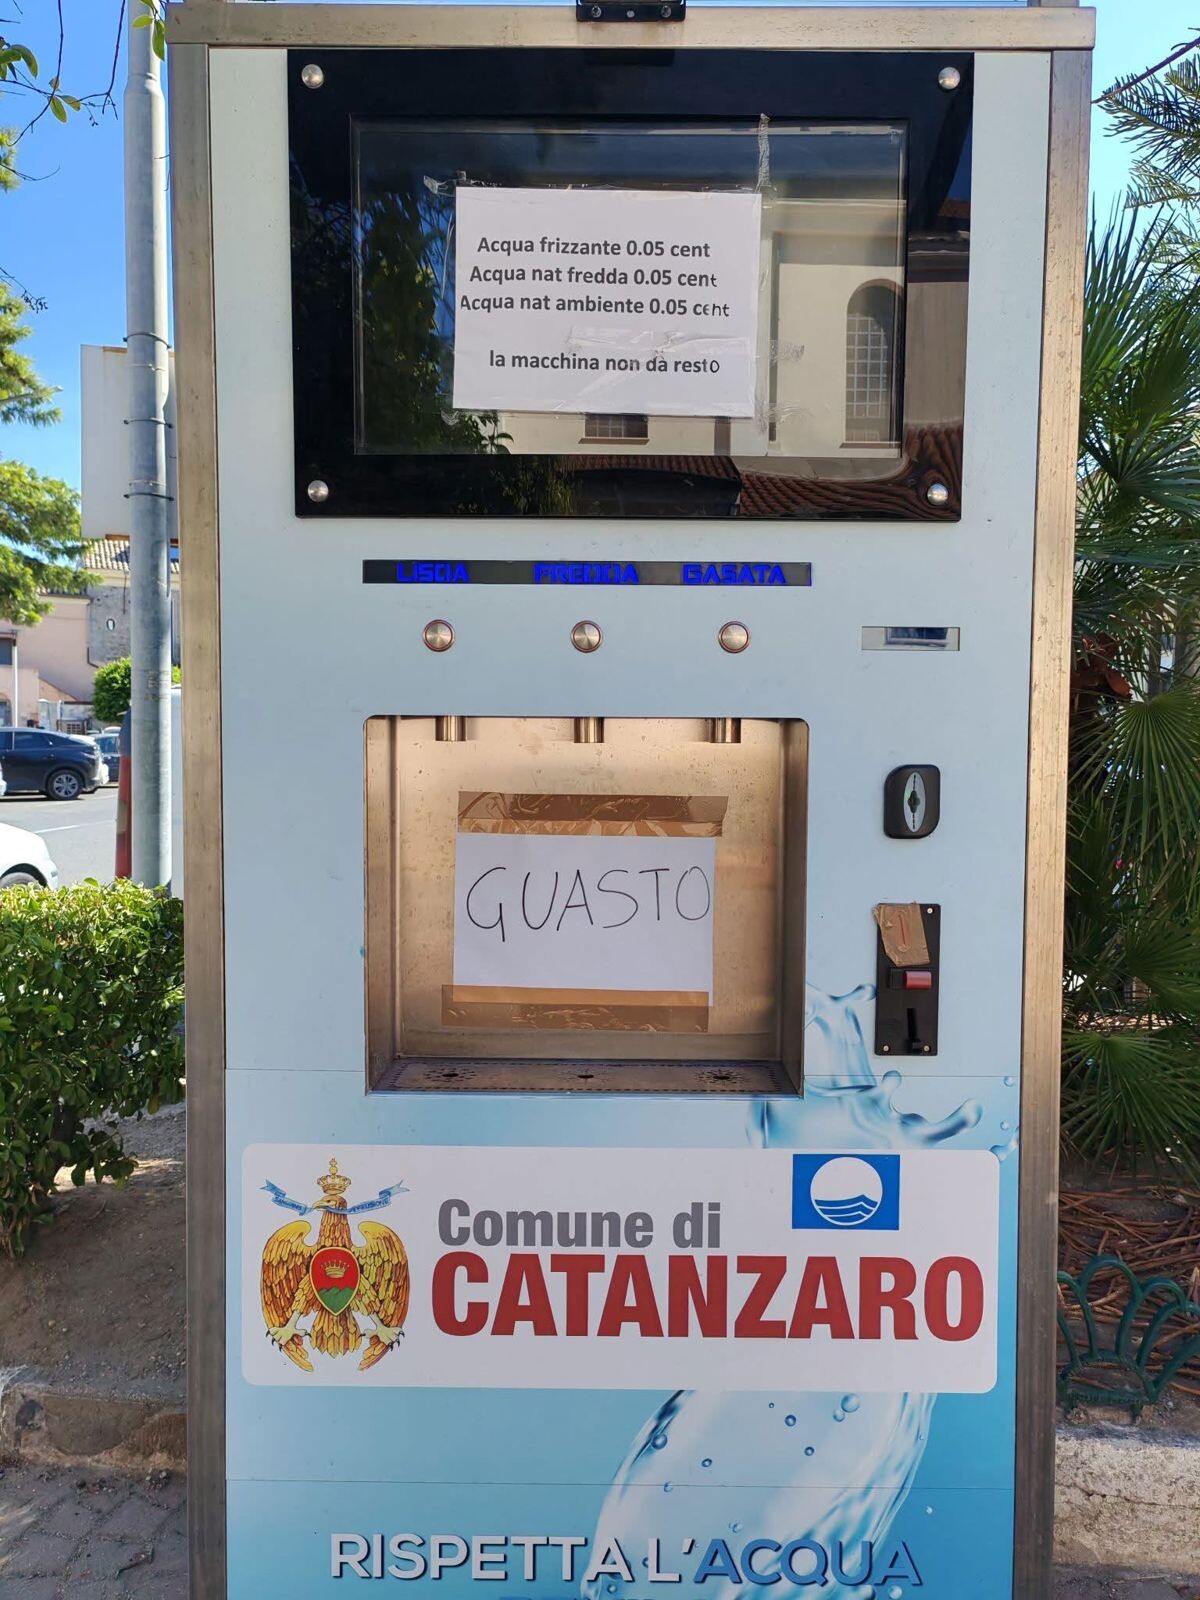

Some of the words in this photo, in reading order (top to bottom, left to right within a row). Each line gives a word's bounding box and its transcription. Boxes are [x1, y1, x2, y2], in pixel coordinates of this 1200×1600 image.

[477, 237, 534, 256] Acqua
[540, 236, 621, 256] frizzante
[626, 239, 665, 256] 0.05
[670, 243, 711, 258] cent
[469, 265, 526, 285] Acqua
[532, 267, 562, 282] nat
[567, 266, 628, 285] fredda
[633, 269, 672, 286] 0.05
[677, 273, 718, 288] cent
[460, 295, 514, 313] Acqua
[520, 295, 550, 311] nat
[556, 295, 644, 313] ambiente
[649, 298, 688, 315] 0.05
[693, 303, 730, 317] cent
[489, 350, 505, 367] la
[511, 352, 600, 370] macchina
[605, 358, 641, 372] non
[673, 359, 720, 374] resto
[534, 563, 640, 585] FREDDA
[683, 563, 786, 585] GASATA
[466, 866, 711, 943] GUASTO
[437, 1198, 654, 1249] Comune
[672, 1201, 721, 1249] di
[431, 1251, 984, 1342] CATANZARO
[330, 1532, 635, 1583] RISPETTA
[648, 1536, 923, 1588] L'ACQUA
